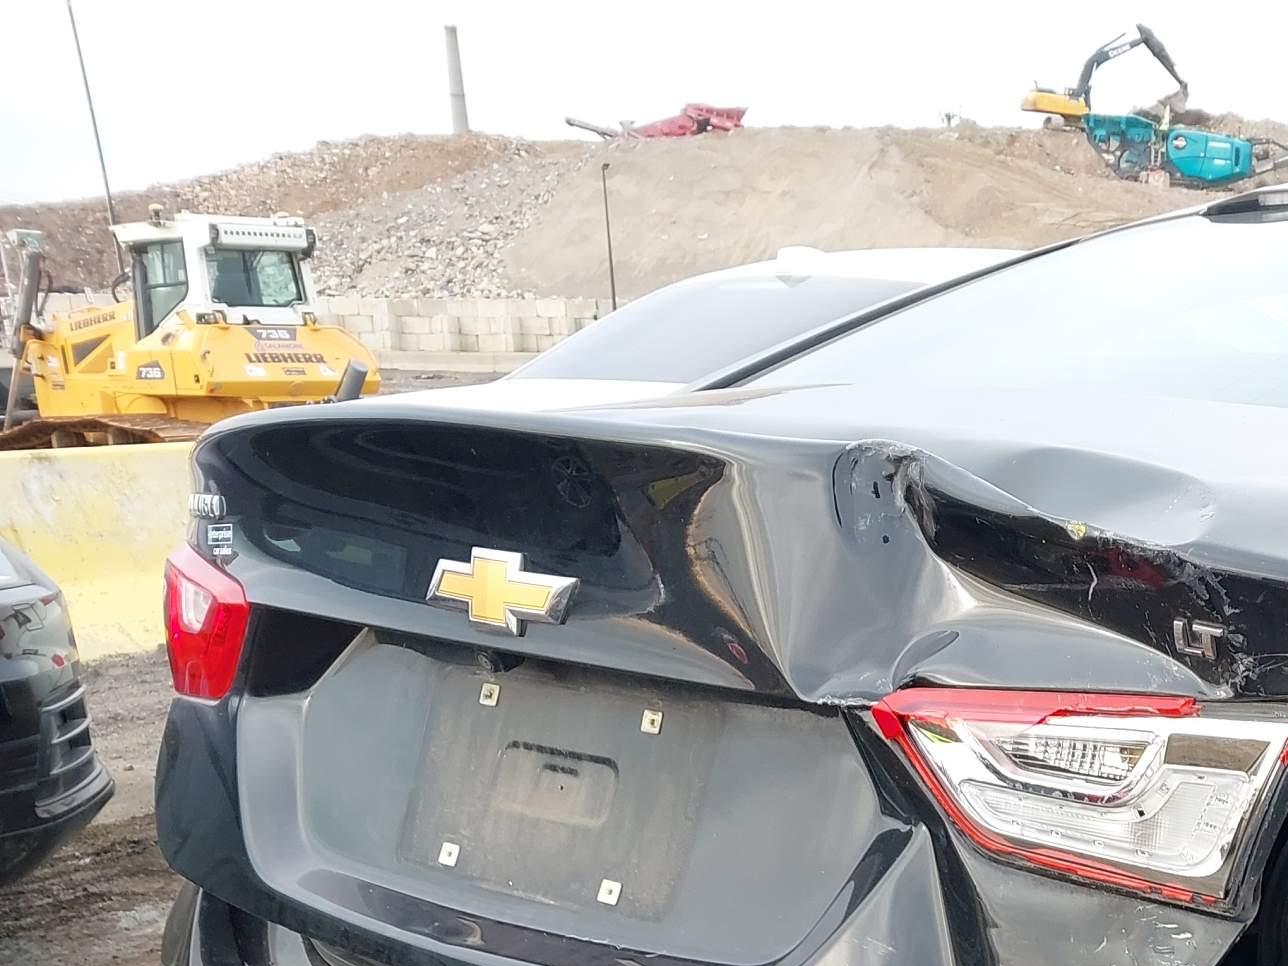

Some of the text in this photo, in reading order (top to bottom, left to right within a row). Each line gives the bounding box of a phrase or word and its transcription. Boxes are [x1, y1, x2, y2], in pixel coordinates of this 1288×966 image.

[69, 311, 116, 331] LIEBHERR
[244, 352, 327, 364] LIEBHERR
[139, 367, 163, 379] 736
[1173, 618, 1226, 659] LT
